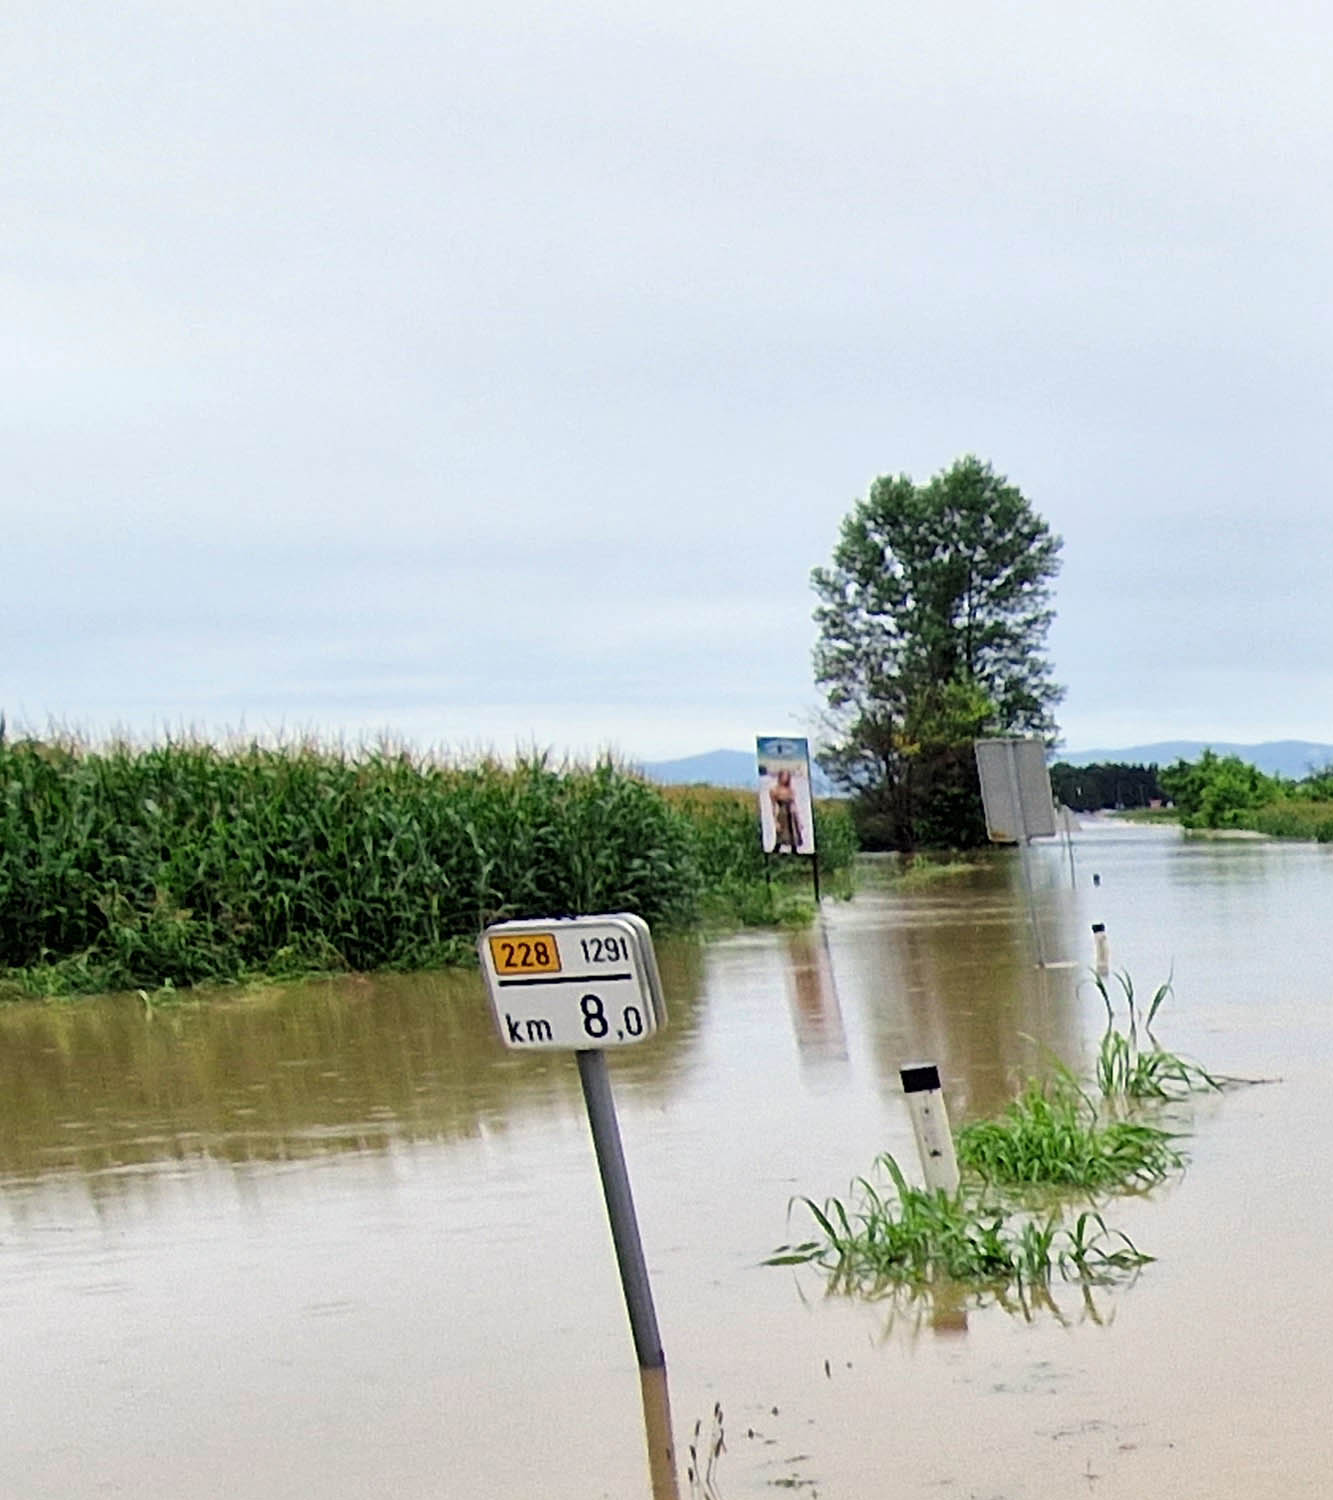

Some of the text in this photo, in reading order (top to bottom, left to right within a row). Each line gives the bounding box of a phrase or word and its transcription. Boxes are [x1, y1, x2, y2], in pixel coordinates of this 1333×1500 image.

[501, 936, 629, 968] 228 1291
[506, 994, 643, 1043] km 8,0
